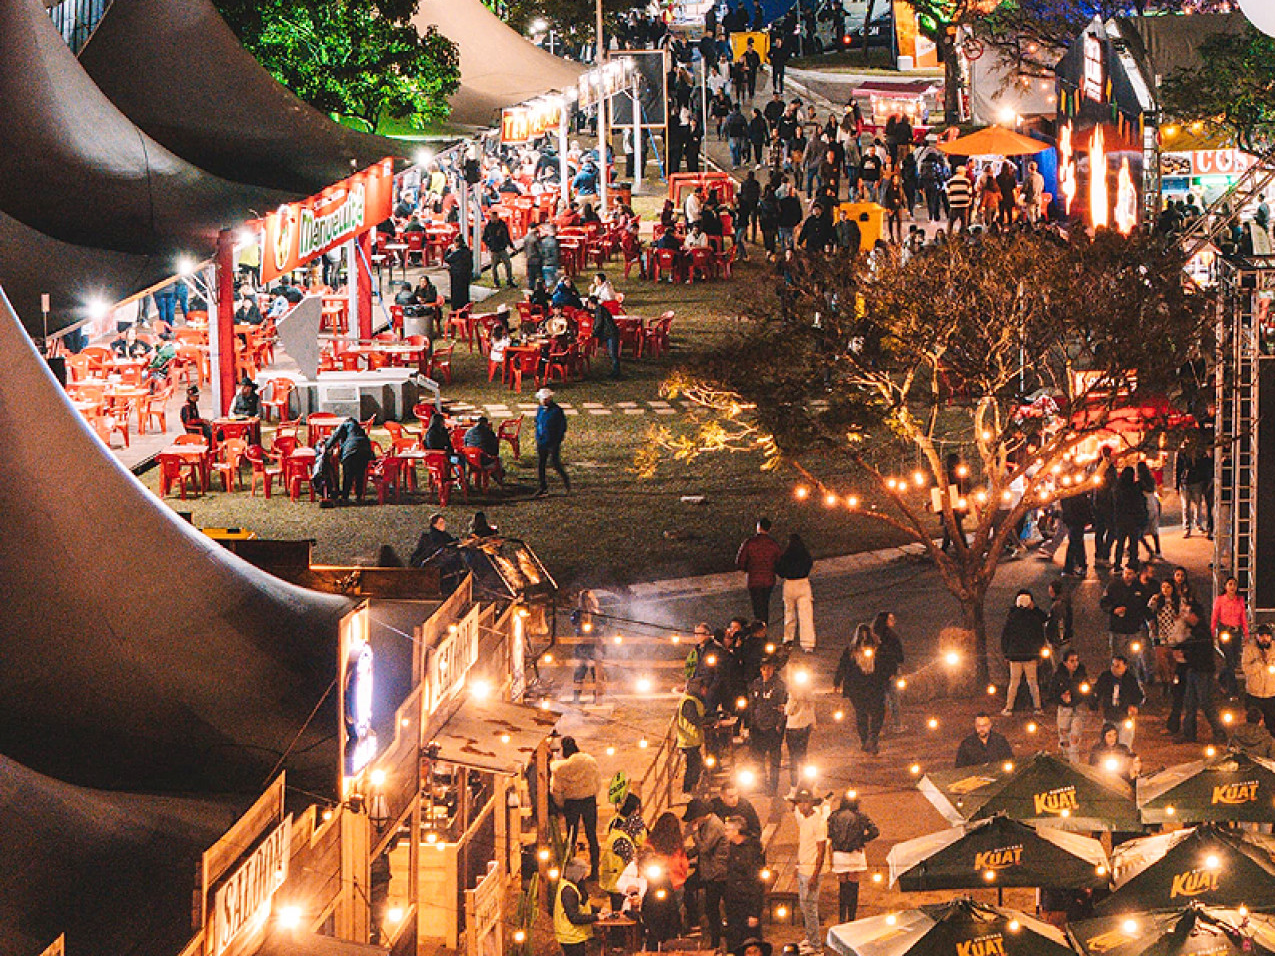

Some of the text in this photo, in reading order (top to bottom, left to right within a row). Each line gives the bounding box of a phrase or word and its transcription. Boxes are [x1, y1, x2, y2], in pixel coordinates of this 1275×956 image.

[1034, 788, 1080, 815] KUAT
[1211, 783, 1260, 805] KUAT
[974, 847, 1023, 872] KUAT
[223, 822, 287, 948] SALOON
[1169, 870, 1221, 899] KUAT
